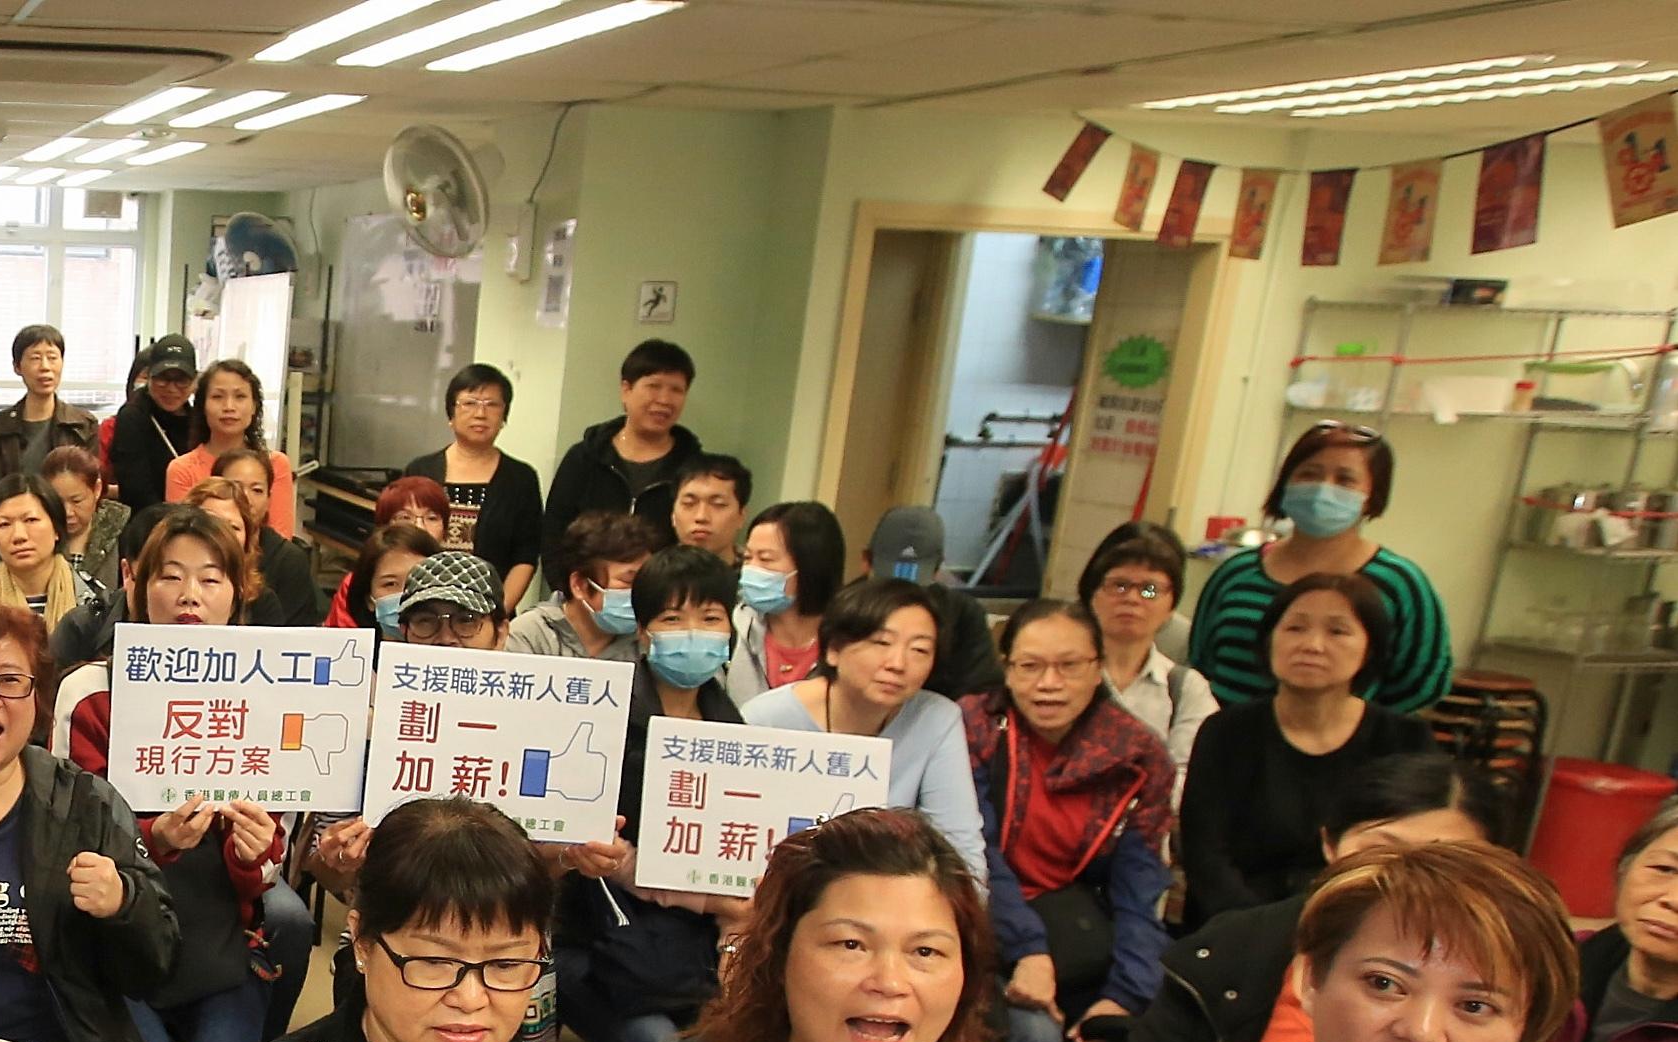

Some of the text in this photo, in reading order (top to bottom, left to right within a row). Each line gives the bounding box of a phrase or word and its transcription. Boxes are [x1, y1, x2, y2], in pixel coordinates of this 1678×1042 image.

[125, 646, 312, 683] 歡迎加人工
[392, 663, 618, 707] 支援職系新人舊人
[163, 699, 249, 740] 反對
[135, 746, 270, 775] 現行方案
[662, 735, 879, 780] 支援職系新人舊人
